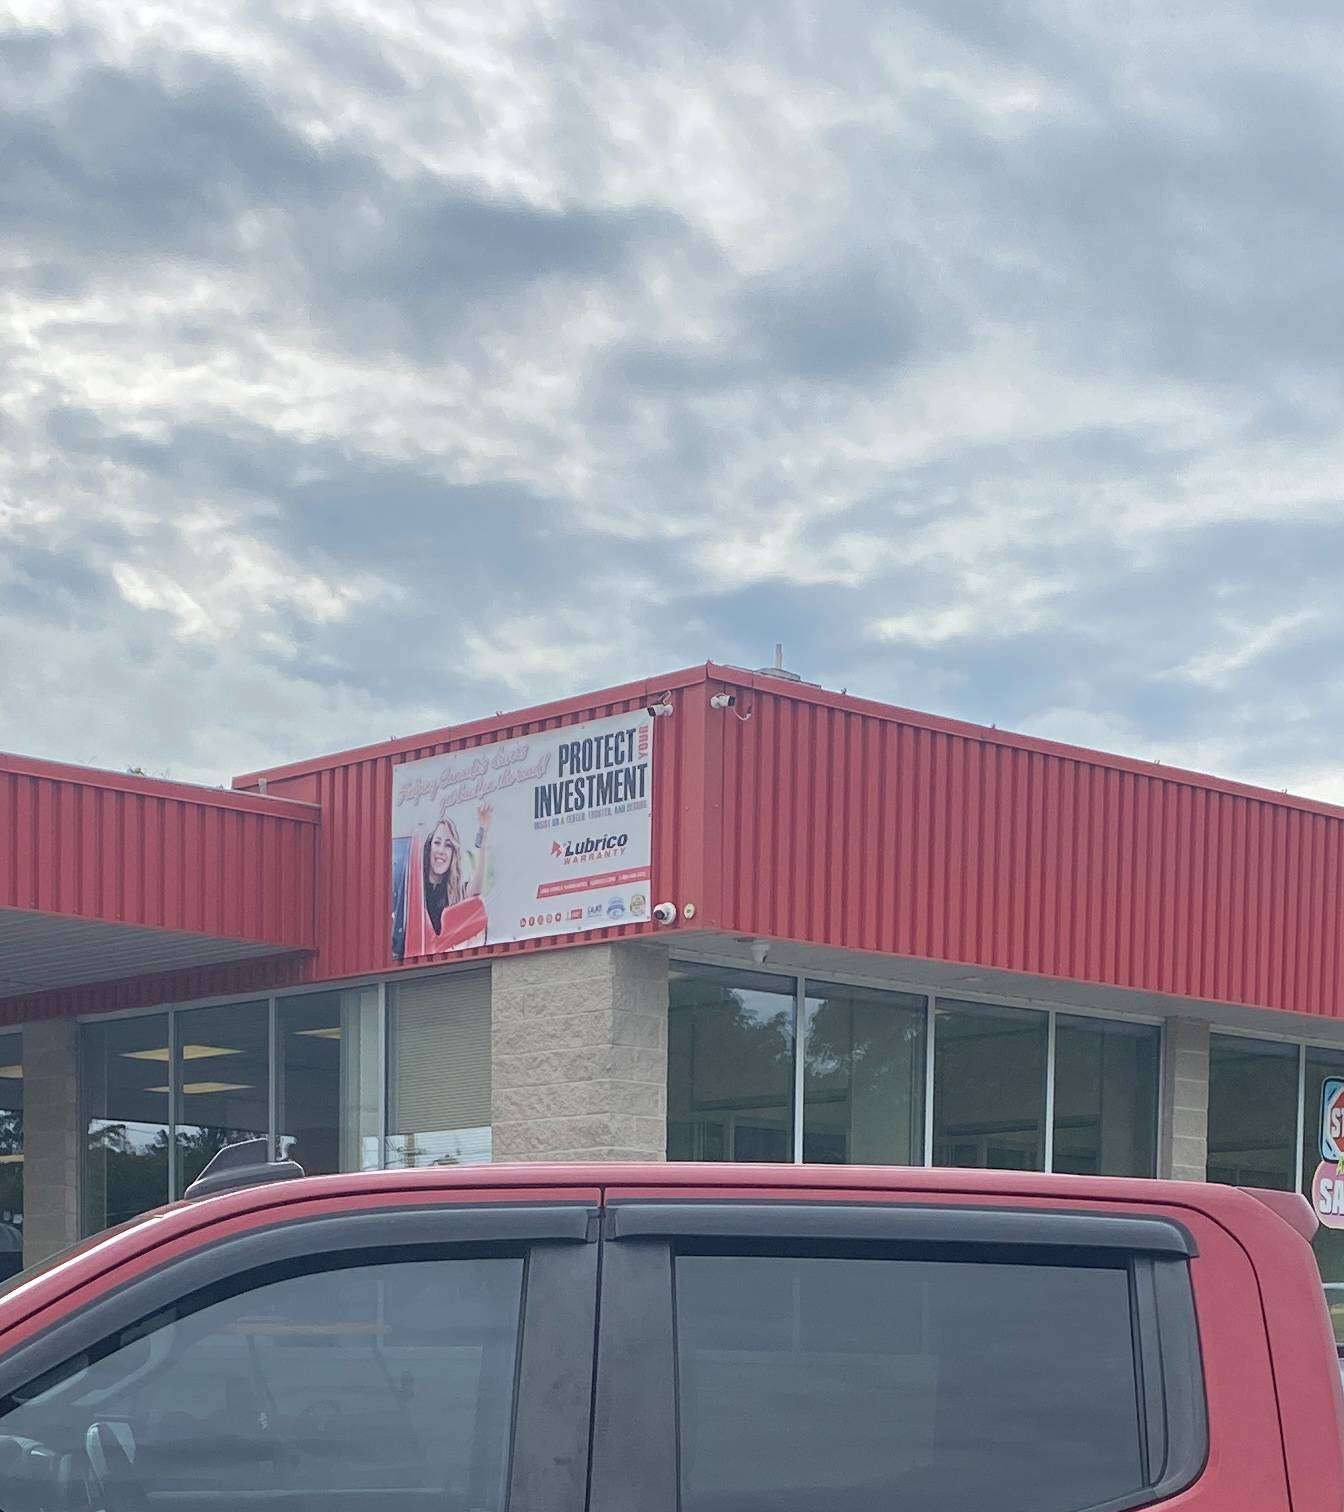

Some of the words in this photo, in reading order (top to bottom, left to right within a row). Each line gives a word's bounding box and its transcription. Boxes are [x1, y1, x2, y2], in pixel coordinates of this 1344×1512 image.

[558, 728, 637, 778] PROTECT
[638, 725, 649, 760] YOUR
[534, 763, 648, 819] INVESTMENT
[563, 848, 627, 865] WARRANTY
[564, 834, 629, 857] Lubrico
